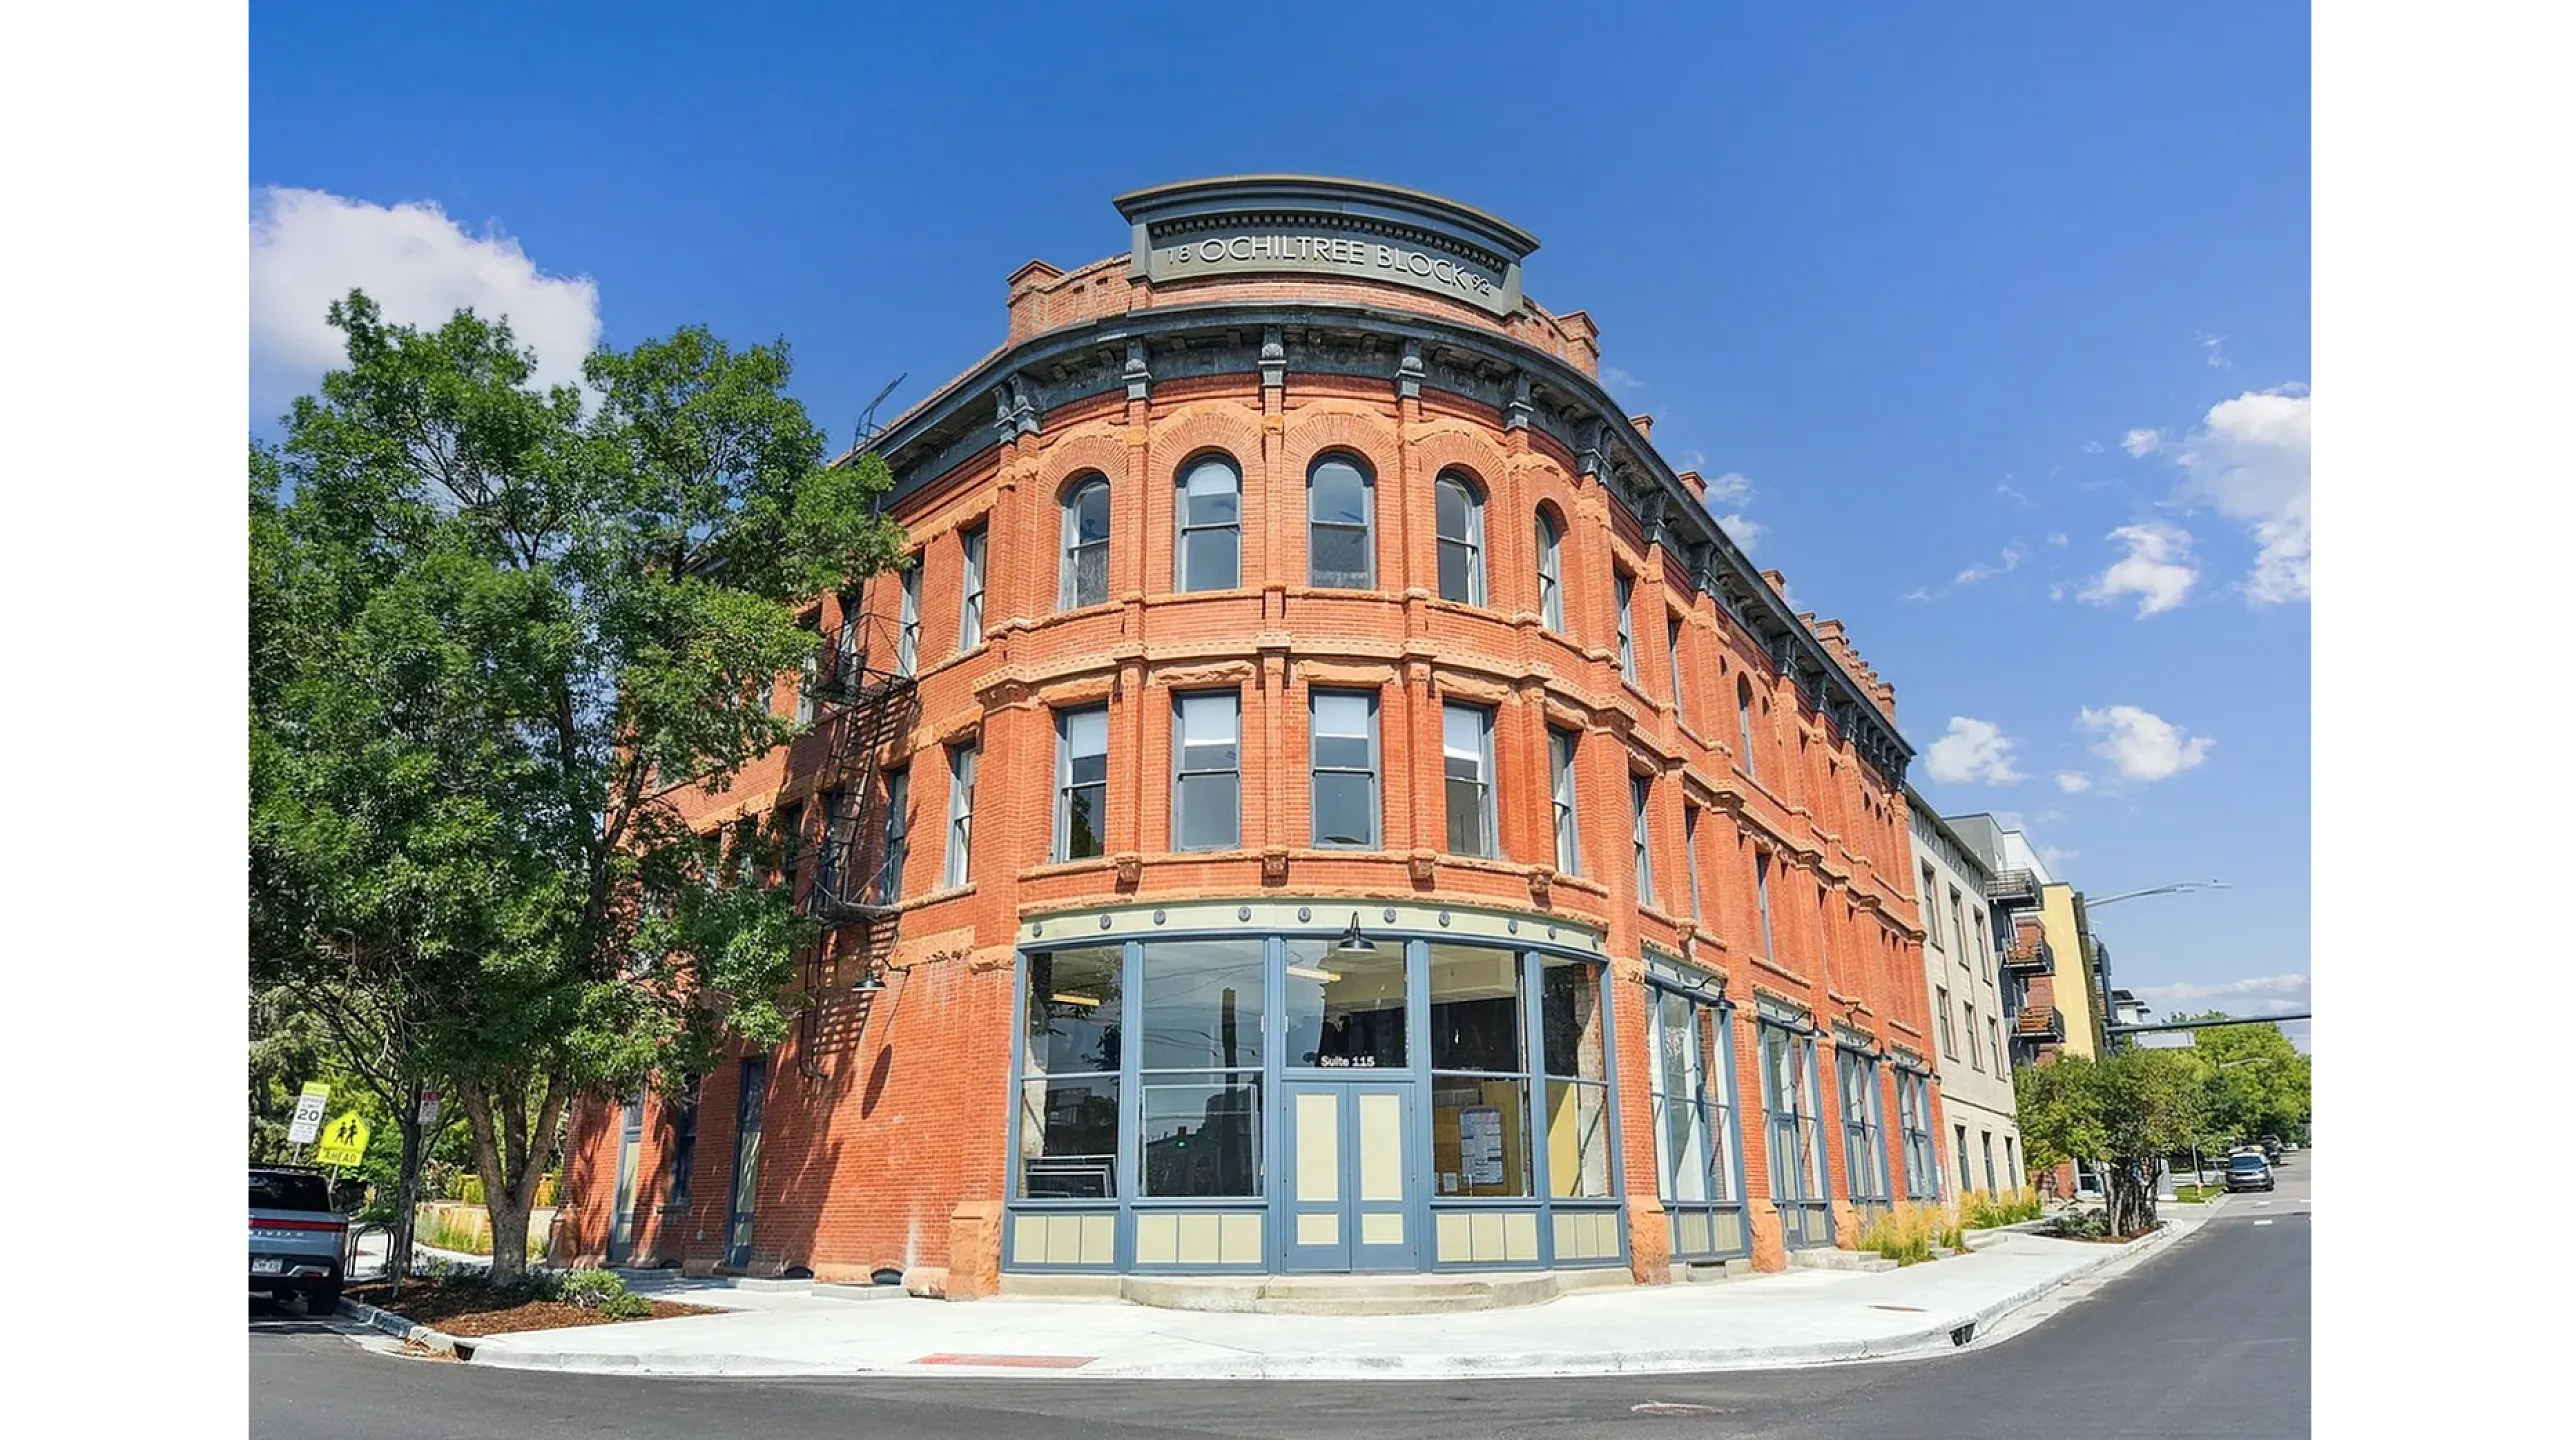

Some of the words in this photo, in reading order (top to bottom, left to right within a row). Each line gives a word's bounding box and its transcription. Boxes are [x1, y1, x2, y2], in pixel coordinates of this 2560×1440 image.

[1167, 245, 1191, 264] 18
[1199, 235, 1365, 266] OCHILTREE
[1377, 243, 1466, 290] BLOCK
[1471, 273, 1491, 296] 92
[1320, 1055, 1350, 1067] Suite
[1351, 1055, 1375, 1067] 115
[297, 1108, 320, 1122] 20
[323, 1150, 357, 1163] AHEAD
